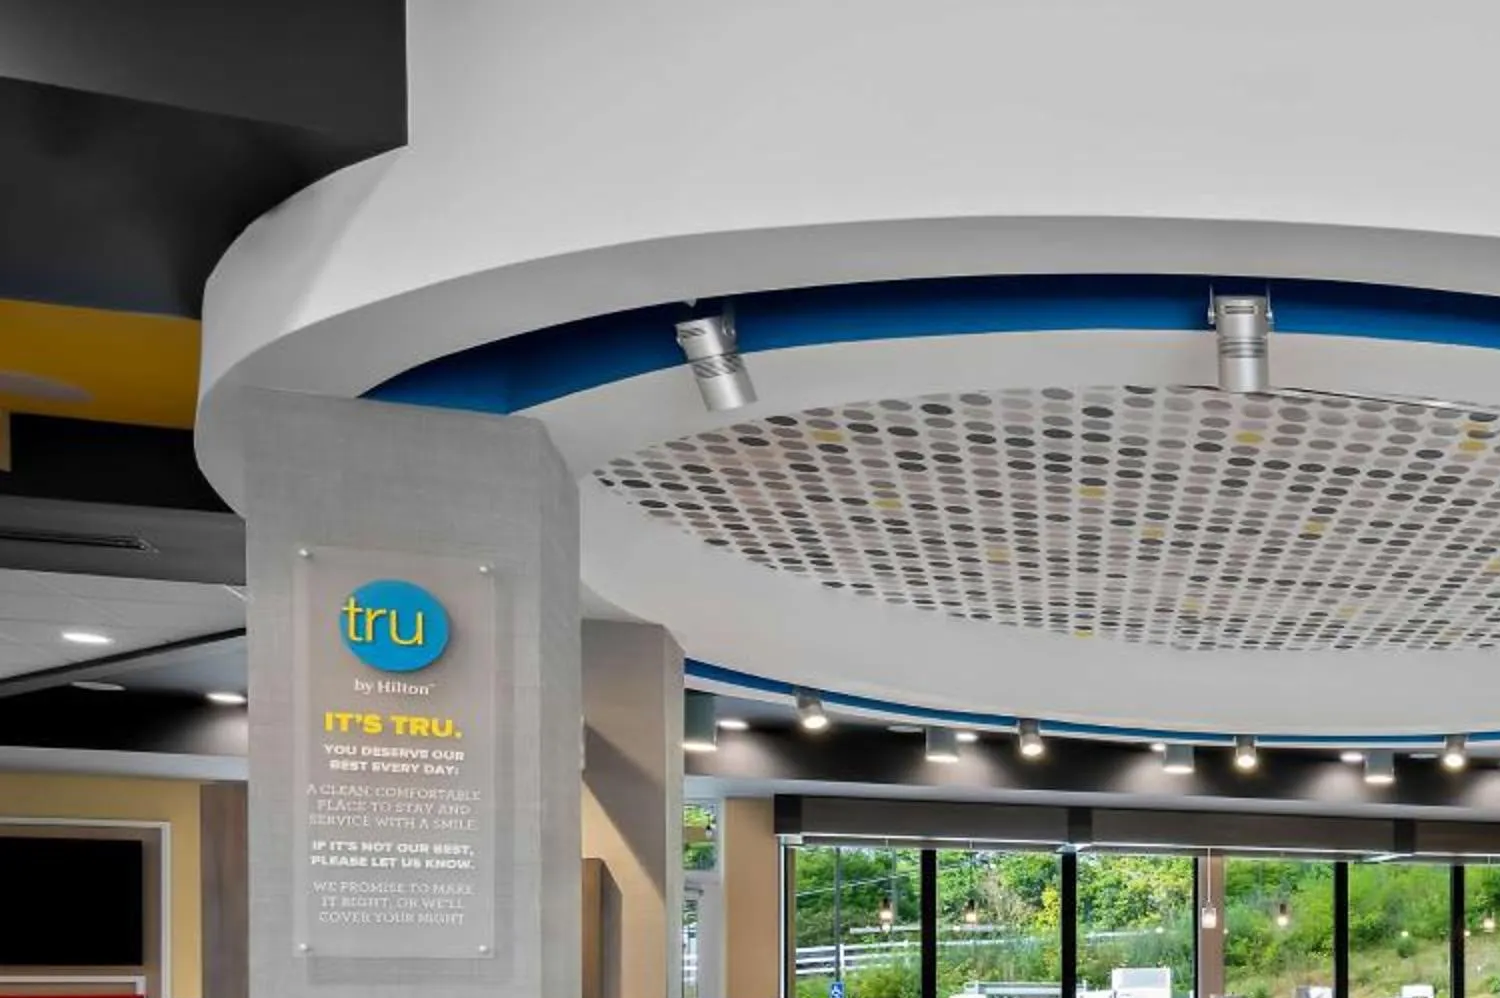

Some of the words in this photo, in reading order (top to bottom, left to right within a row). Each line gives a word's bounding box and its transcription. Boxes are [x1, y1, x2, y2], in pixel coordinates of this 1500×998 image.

[341, 596, 425, 645] tru
[354, 678, 374, 695] by
[377, 680, 430, 696] Hilton
[323, 711, 384, 735] IT'S
[390, 714, 464, 739] TRU.
[324, 744, 357, 756] YOU
[361, 745, 429, 760] DESERVE
[431, 750, 465, 761] OUR
[329, 759, 368, 771] BEST
[371, 761, 420, 773] EVERY
[305, 783, 318, 796] A
[374, 786, 481, 801] COMFORTABLE
[317, 799, 368, 812] PLACE
[370, 801, 392, 813] TO
[394, 802, 434, 815] STAY
[437, 803, 472, 816] AND
[308, 813, 370, 827] SERVICE
[375, 816, 416, 830] WITH
[419, 817, 430, 830] A
[313, 840, 327, 851] IF
[330, 841, 358, 851] IT'S
[361, 842, 394, 853] NOT
[397, 843, 430, 854] OUR
[310, 855, 369, 867] PLEASE
[371, 856, 398, 868] LET
[401, 856, 421, 869] US
[312, 881, 338, 893] WE
[409, 883, 431, 894] TO
[321, 896, 337, 907] IT
[396, 898, 418, 910] OR
[318, 911, 372, 923] COVER
[374, 911, 415, 923] YOUR
